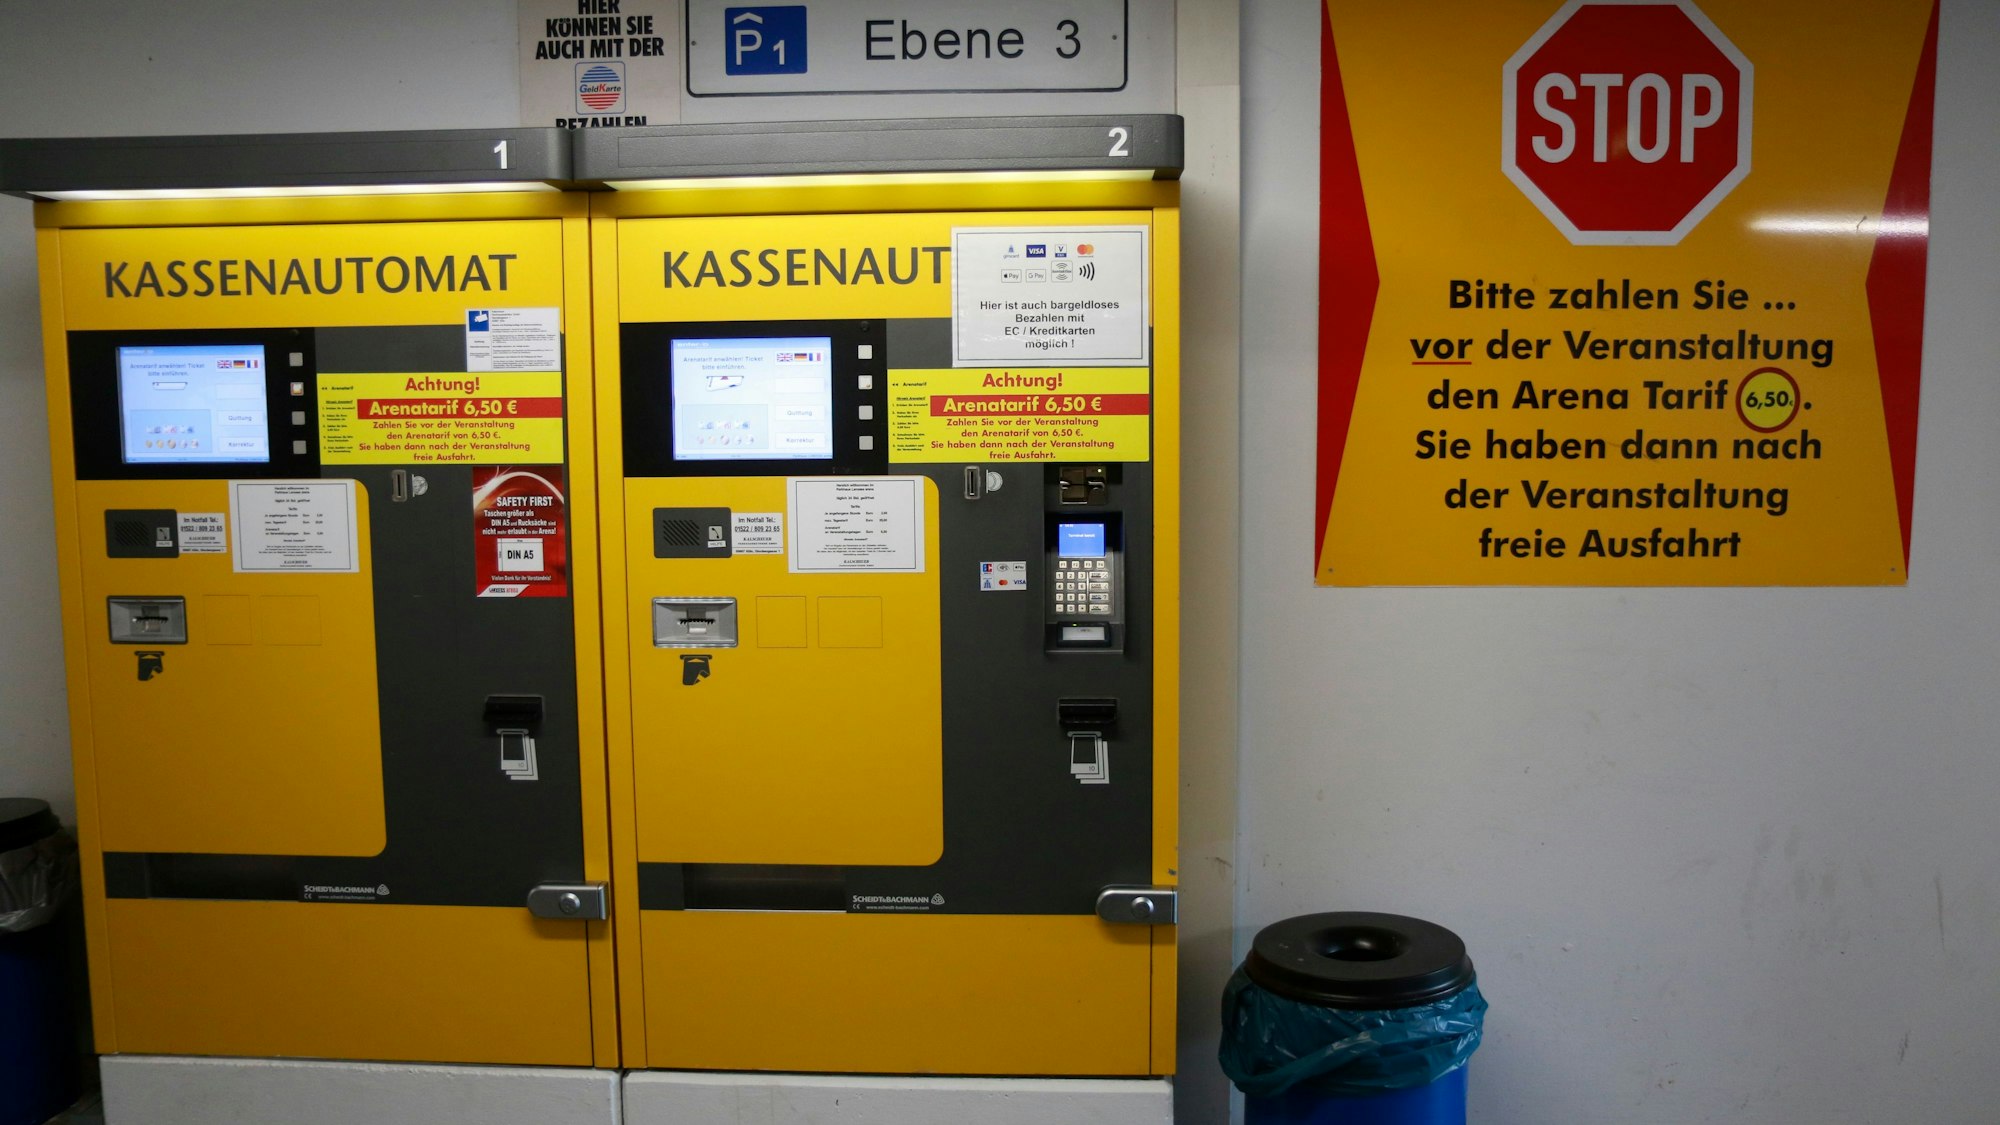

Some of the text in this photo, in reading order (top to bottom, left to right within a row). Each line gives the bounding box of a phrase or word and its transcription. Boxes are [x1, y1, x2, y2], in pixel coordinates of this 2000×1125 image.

[578, 0, 620, 15] HIER
[546, 16, 653, 38] KÖNNEN SIE
[865, 19, 1082, 61] Ebene 3
[535, 38, 664, 60] AUCH MIT DER
[579, 83, 622, 94] GeldKarte
[1531, 73, 1723, 164] STOP
[1108, 127, 1128, 157] 2
[493, 140, 508, 170] 1
[664, 247, 951, 288] KASSENAUT
[104, 254, 517, 298] KASSENAUTOMAT
[1450, 279, 1796, 310] Bitte zahlen Sie ...
[980, 300, 1120, 312] Hier ist auch bargeldloses
[1015, 314, 1085, 323] Bezahlen mit
[1004, 326, 1020, 336] EC
[1029, 326, 1096, 336] Kreditkarten
[1025, 339, 1068, 351] möglich
[1410, 329, 1833, 368] vor der Veranstaltung
[405, 376, 480, 395] Achtung!
[982, 371, 1063, 391] Achtung!
[1427, 379, 1498, 410] den
[1512, 380, 1629, 410] Arena
[1643, 379, 1728, 410] Tarif
[369, 399, 518, 417] Arenatarif 6,50 €
[943, 396, 1102, 414] Arenatarif 6,50 €
[373, 421, 402, 429] Zahlen
[405, 421, 417, 429] Sie
[437, 421, 451, 429] der
[455, 420, 515, 430] Veranstaltung
[947, 418, 978, 427] Zahlen
[981, 418, 995, 427] Sie
[1016, 418, 1031, 426] der
[1034, 418, 1099, 428] Veranstaltung
[386, 432, 403, 440] den
[406, 431, 451, 440] Arenatarif
[471, 431, 491, 440] 6,50
[493, 431, 501, 439] €.
[961, 429, 978, 438] den
[982, 429, 1030, 438] Arenatarif
[1052, 429, 1073, 438] 6,50
[1075, 429, 1084, 437] €.
[359, 442, 531, 452] Sie haben dann nach der Veranstaltung
[931, 440, 1115, 450] Sie haben dann nach der Veranstaltung
[1415, 429, 1822, 460] Sie haben dann nach
[413, 453, 476, 461] freie Ausfahrt.
[989, 451, 1056, 459] freie Ausfahrt.
[496, 496, 553, 507] SAFETY FIRST
[1444, 478, 1788, 517] der Veranstaltung
[507, 509, 525, 518] größer
[526, 509, 535, 517] als
[491, 519, 501, 527] DIN
[502, 519, 510, 527] A5
[518, 519, 548, 527] Rucksäcke
[538, 527, 557, 535] Arena!
[1478, 527, 1741, 558] freie Ausfahrt
[507, 550, 534, 560] DIN A5
[853, 895, 929, 903] SCHEIDT&BACHMANN
